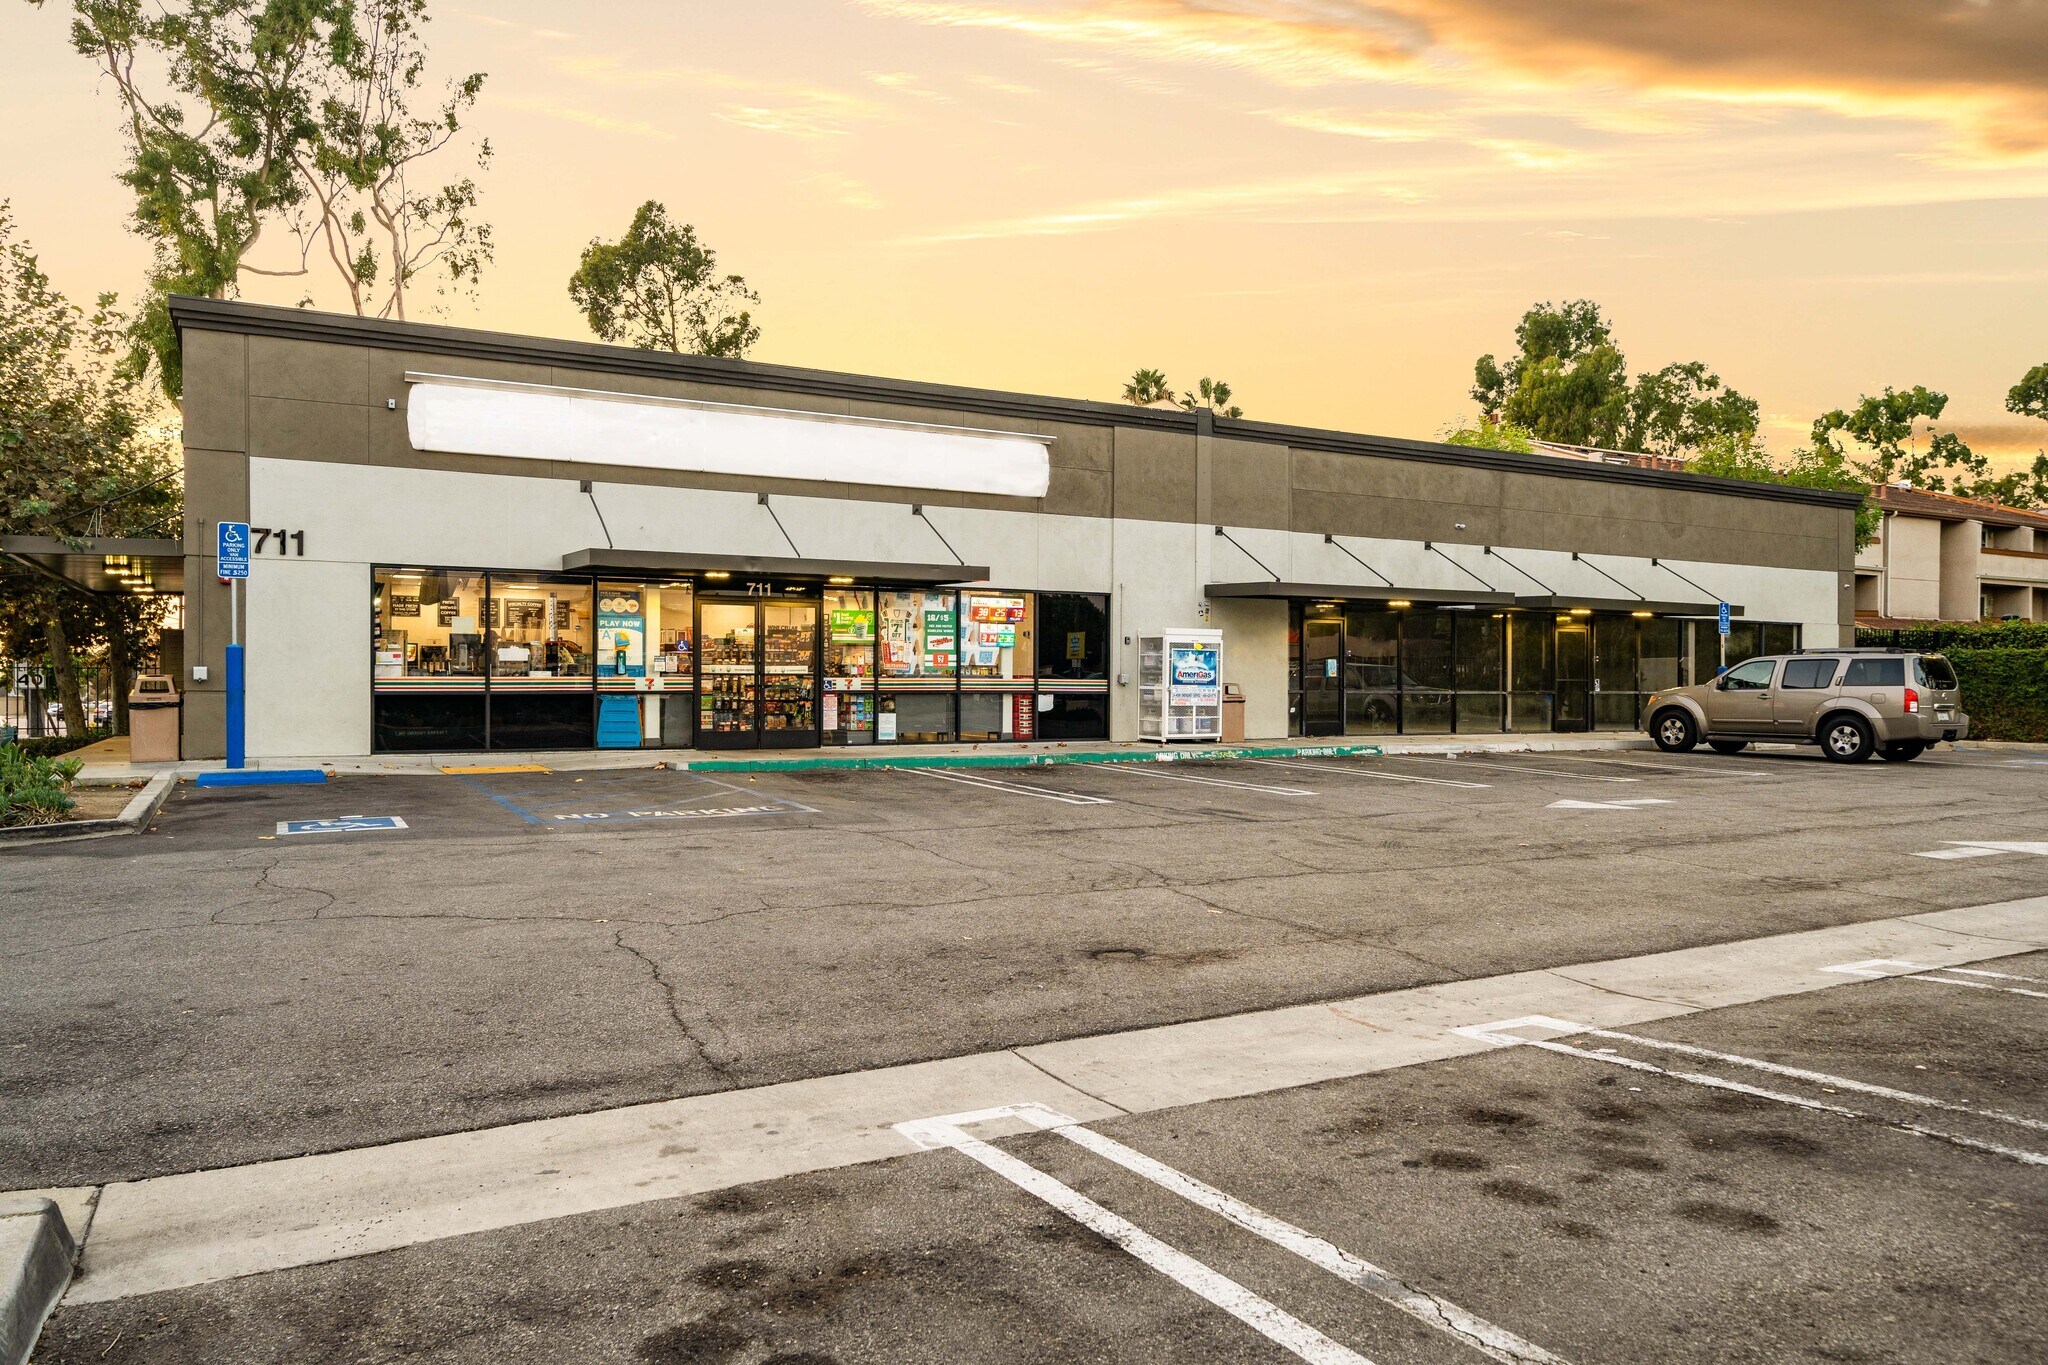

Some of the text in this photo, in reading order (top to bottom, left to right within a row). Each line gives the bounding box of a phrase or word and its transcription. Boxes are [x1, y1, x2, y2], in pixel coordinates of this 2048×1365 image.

[251, 527, 304, 557] 711
[746, 582, 771, 597] 711
[622, 620, 640, 628] NOW
[602, 629, 611, 640] A
[1177, 670, 1212, 679] AmeriGas
[554, 805, 784, 820] NO PARKING
